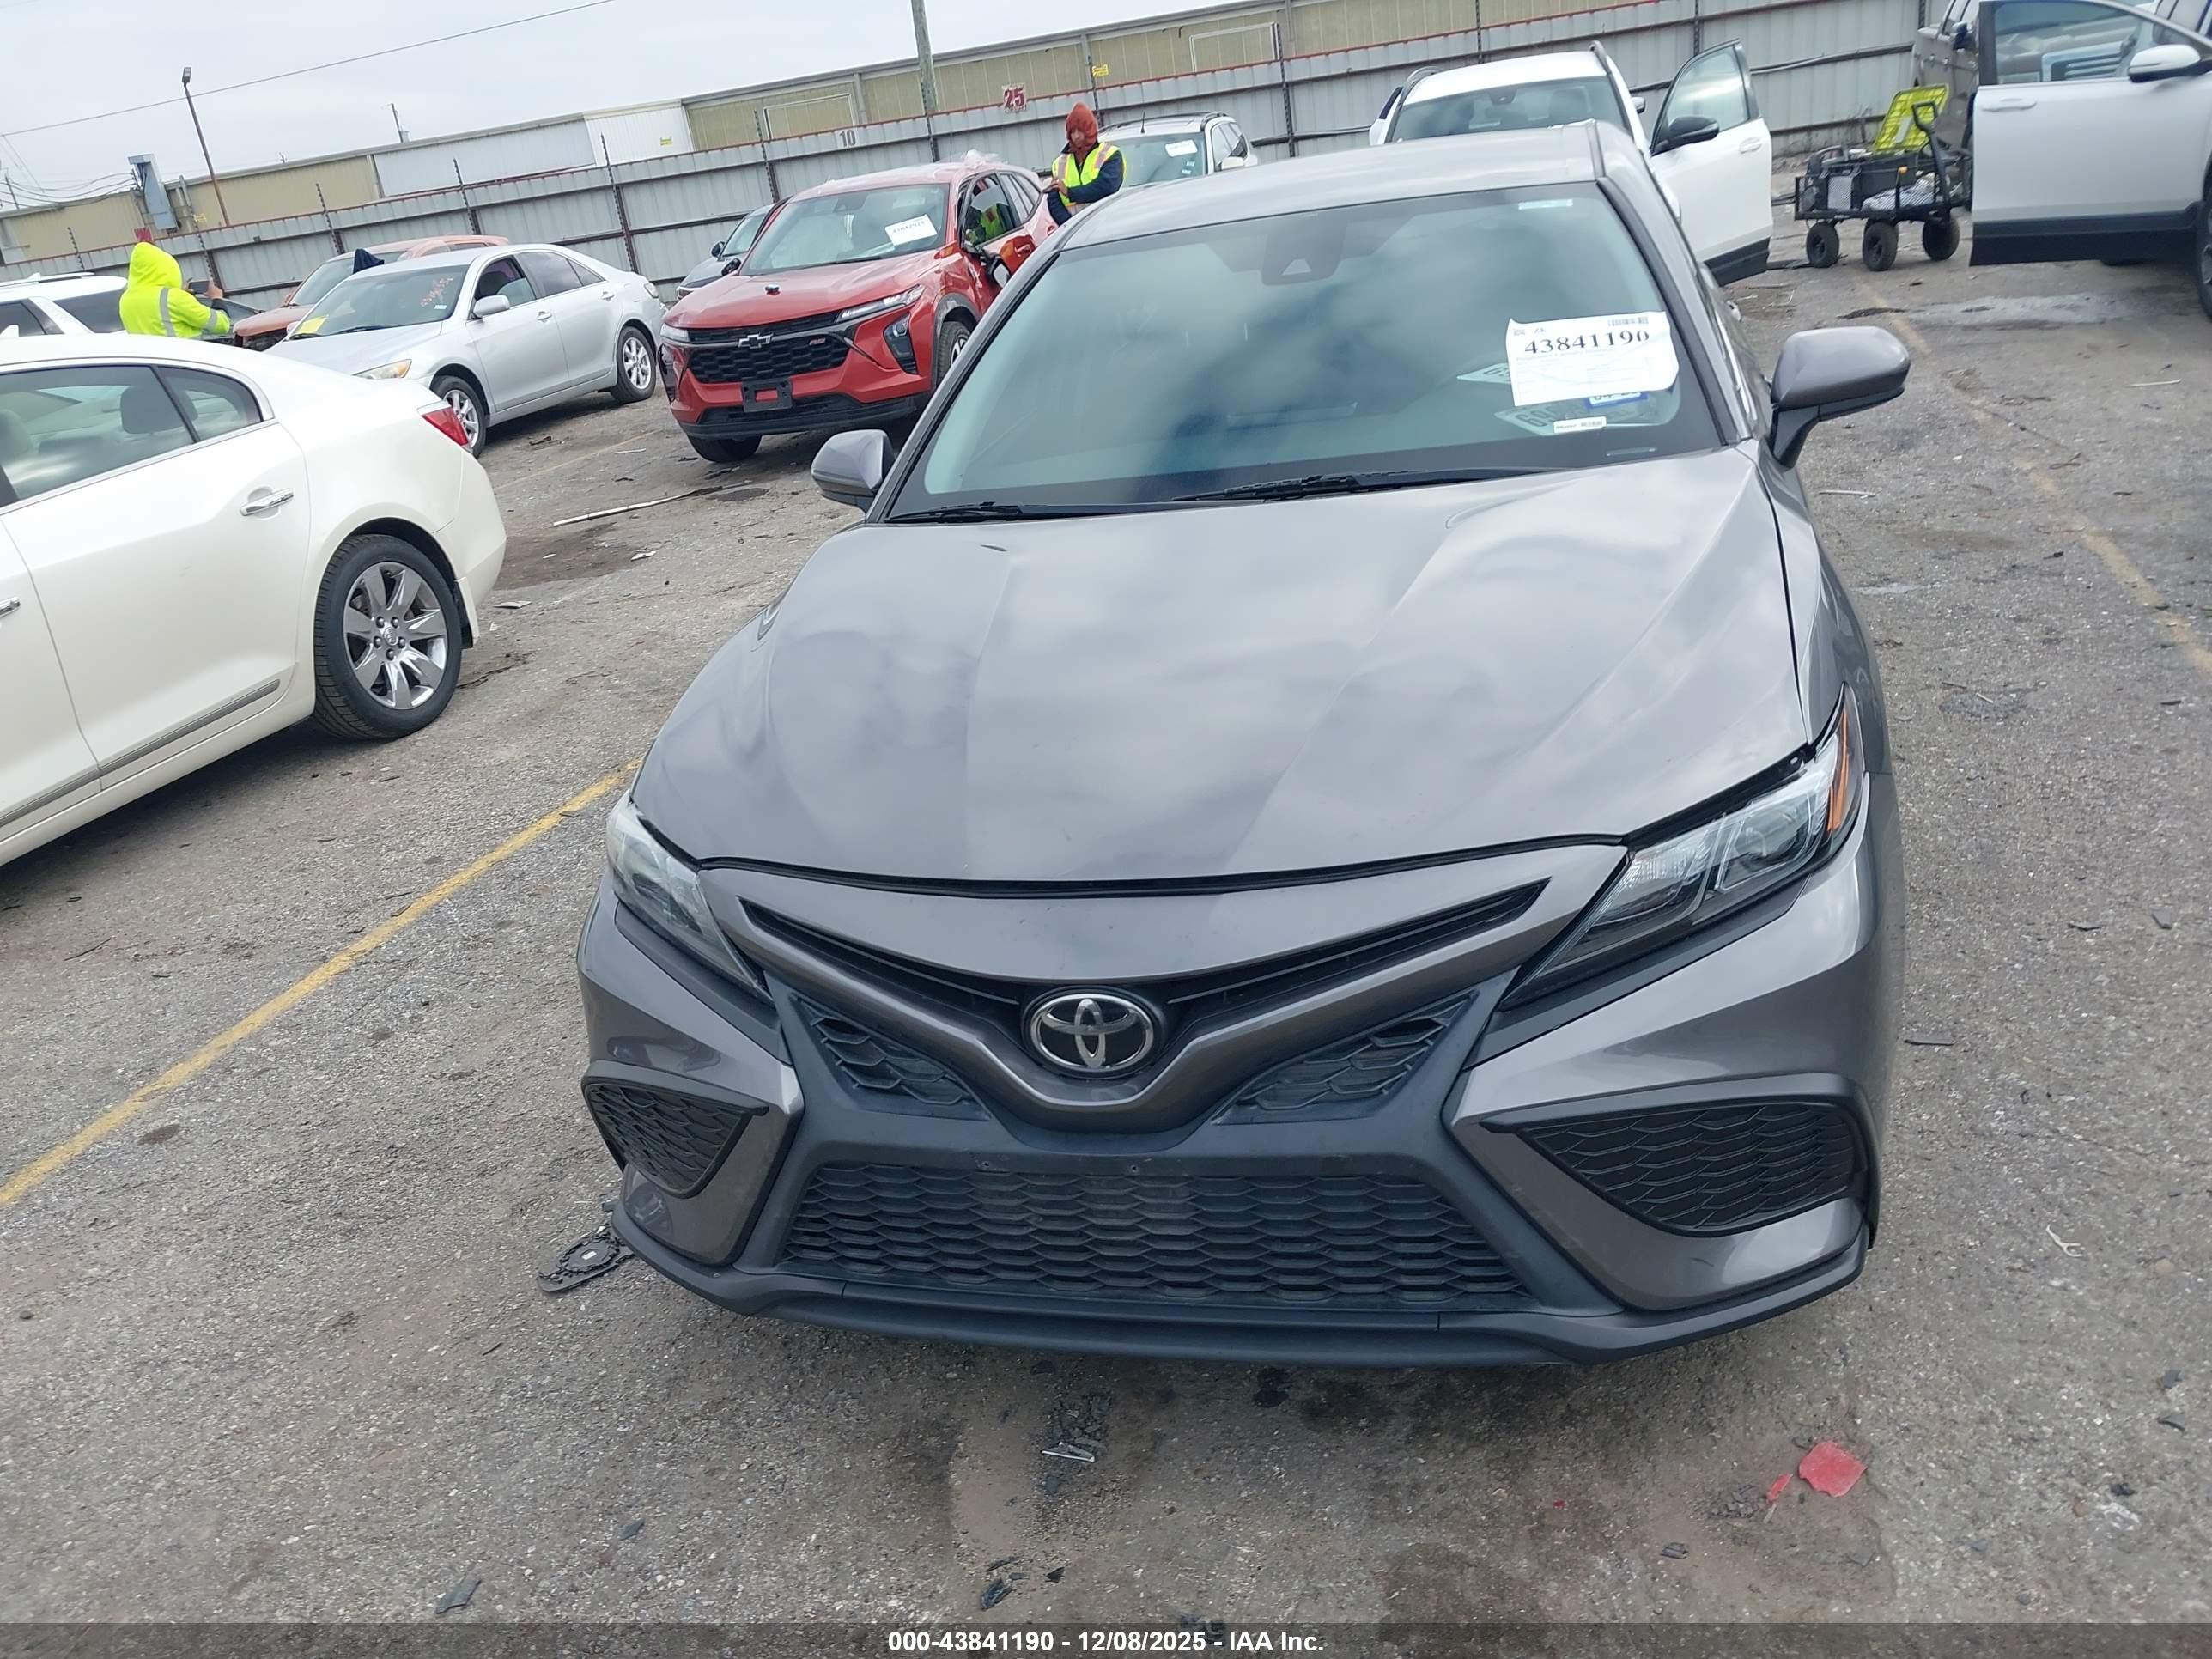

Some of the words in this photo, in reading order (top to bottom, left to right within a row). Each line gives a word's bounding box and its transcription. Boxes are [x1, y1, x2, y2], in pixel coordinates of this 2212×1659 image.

[1003, 87, 1026, 108] 25
[839, 129, 857, 148] 10
[1524, 330, 1650, 354] 43841190
